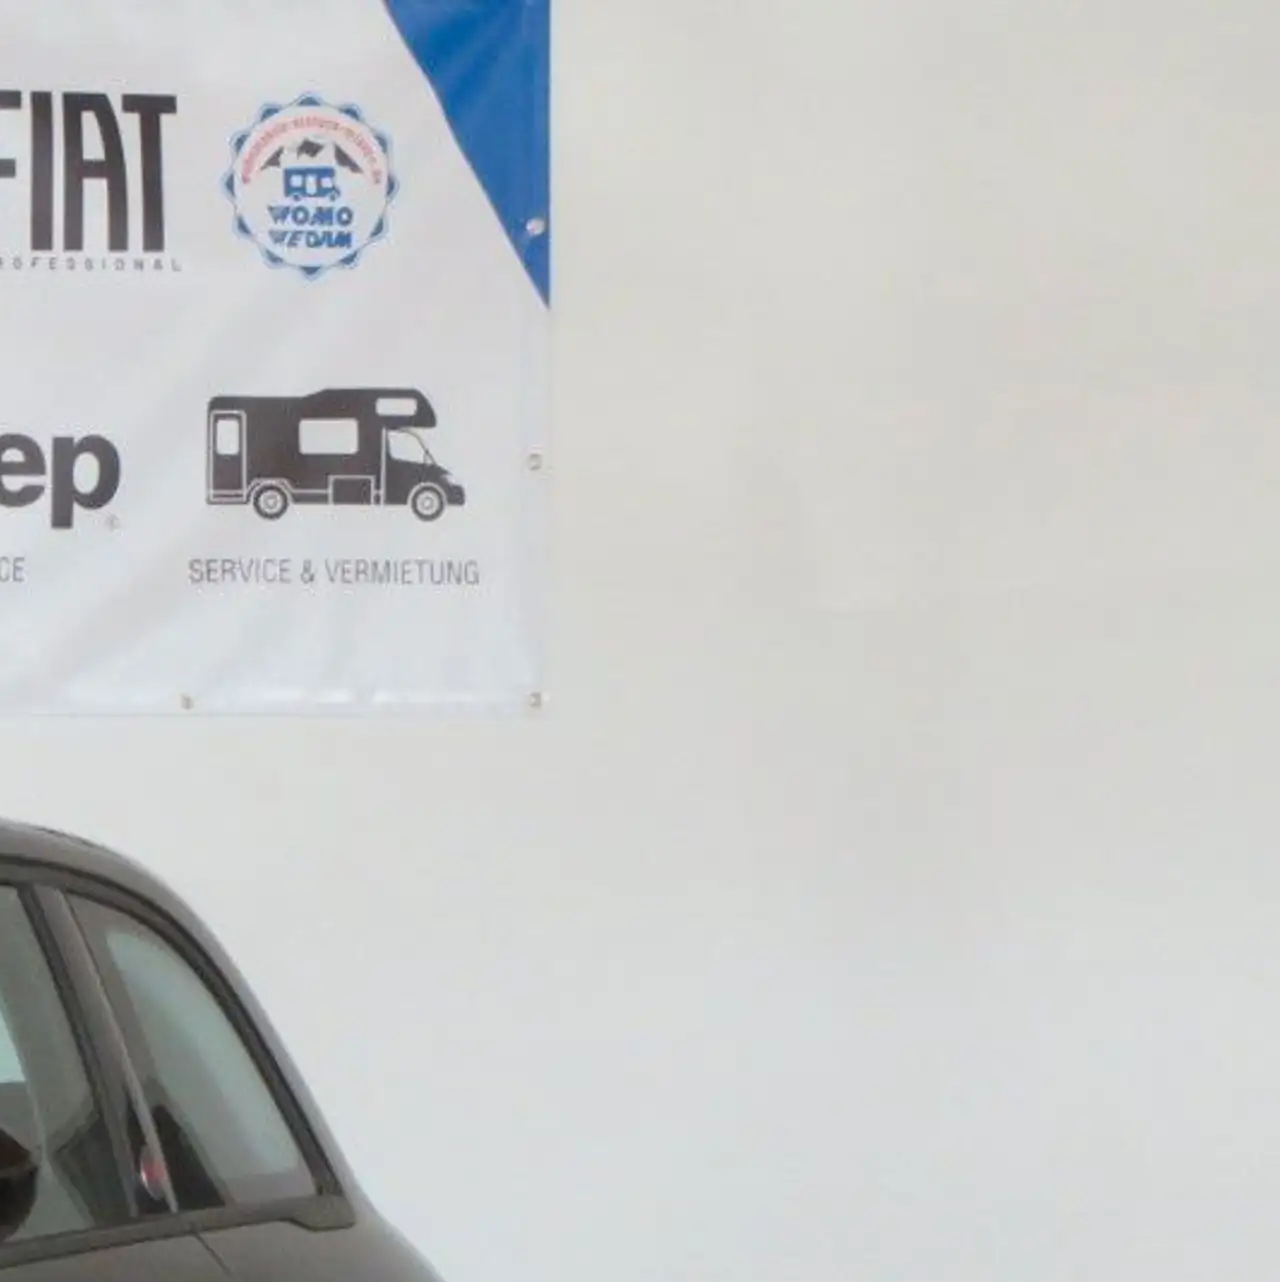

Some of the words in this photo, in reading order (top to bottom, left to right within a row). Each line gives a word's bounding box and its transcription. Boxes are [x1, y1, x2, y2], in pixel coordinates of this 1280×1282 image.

[268, 205, 353, 226] WOMO
[268, 230, 353, 249] WEDAM
[188, 558, 292, 584] SERVICE
[300, 559, 316, 584] &
[325, 559, 480, 585] VERMIETUNG
